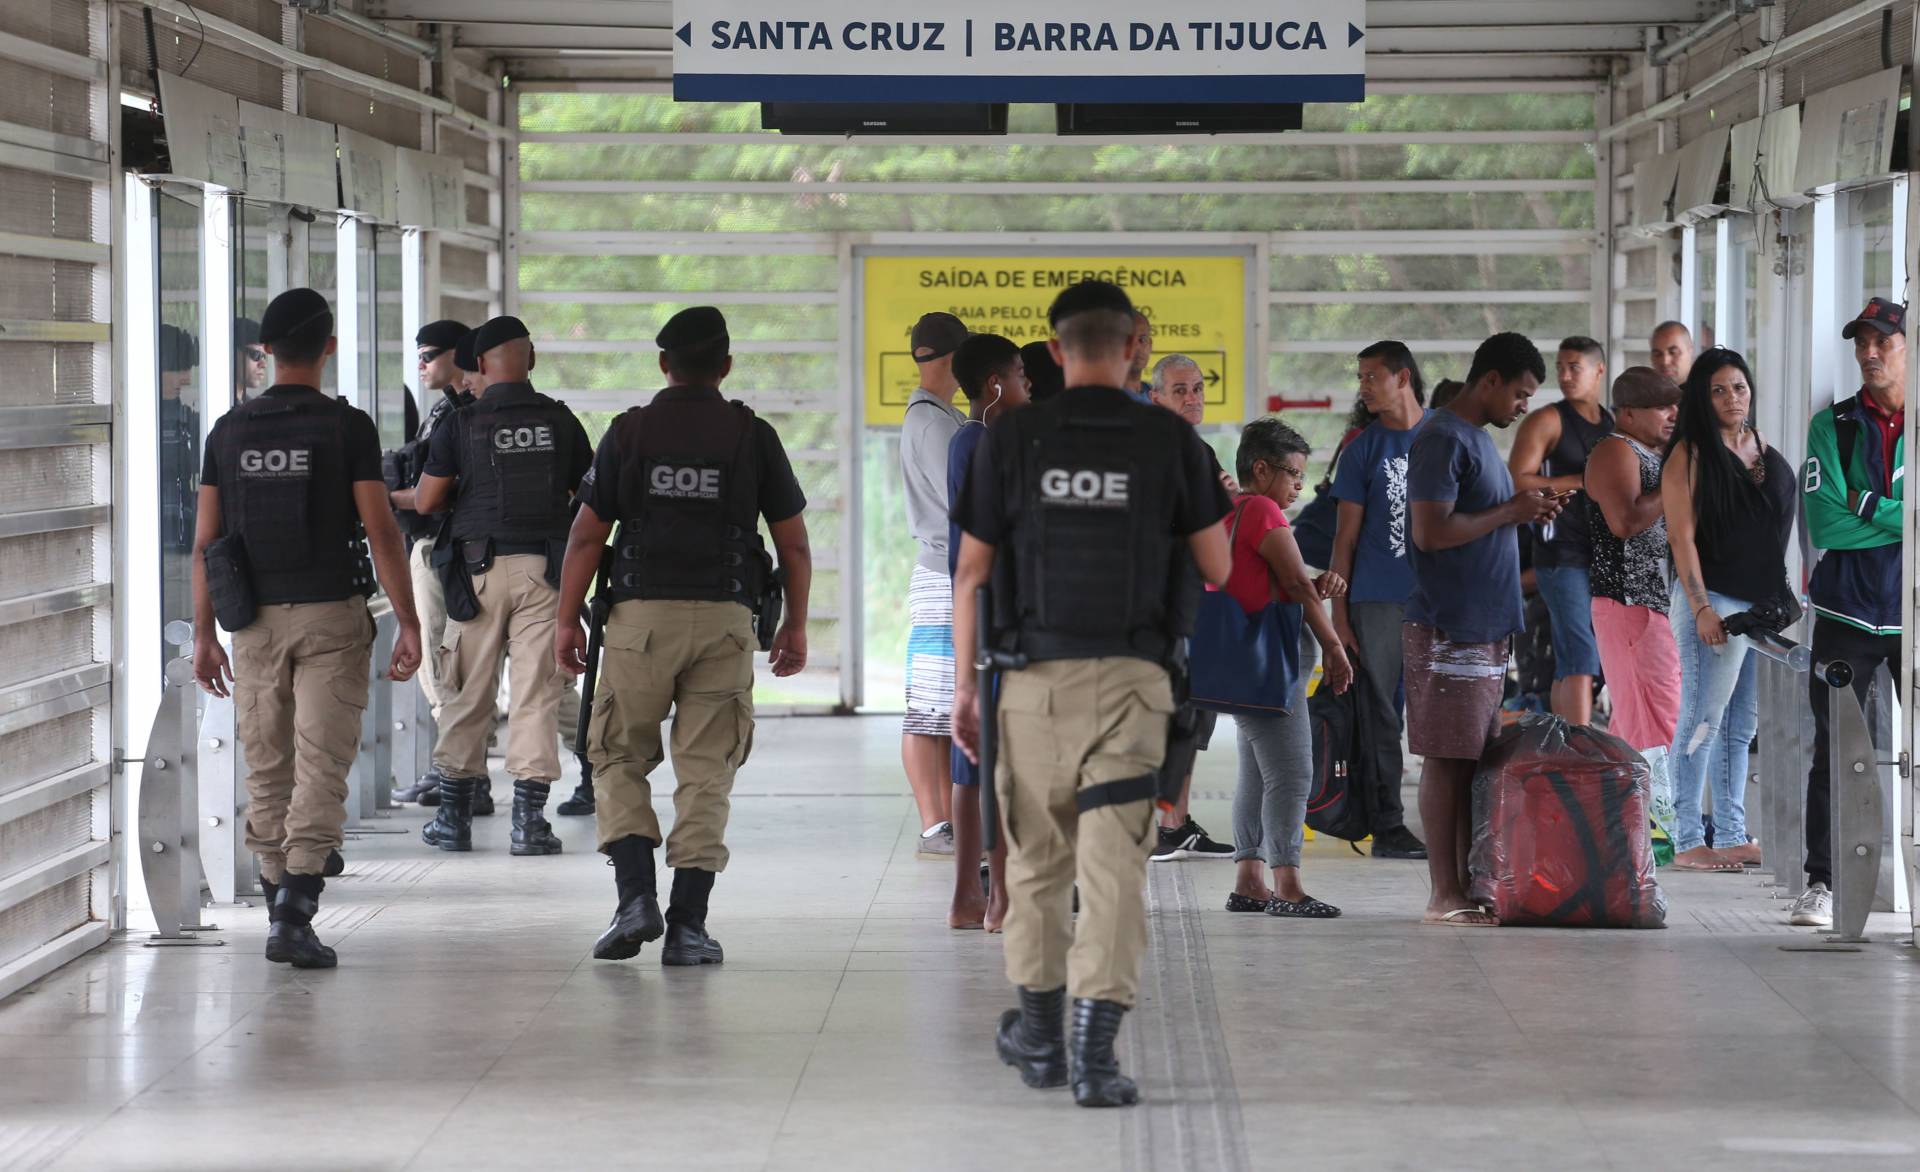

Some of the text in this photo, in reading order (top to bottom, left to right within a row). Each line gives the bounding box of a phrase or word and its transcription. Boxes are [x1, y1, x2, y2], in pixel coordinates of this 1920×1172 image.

[711, 20, 946, 51] SANTA CRUZ
[994, 21, 1328, 51] BARRA DA TIJUCA
[919, 267, 989, 288] SAÍDA
[996, 270, 1026, 288] DE
[991, 306, 1032, 319] PELO
[1003, 325, 1025, 337] NA
[494, 426, 552, 449] GOE
[240, 449, 309, 472] GOE
[650, 465, 720, 492] GOE
[1040, 468, 1129, 499] GOE
